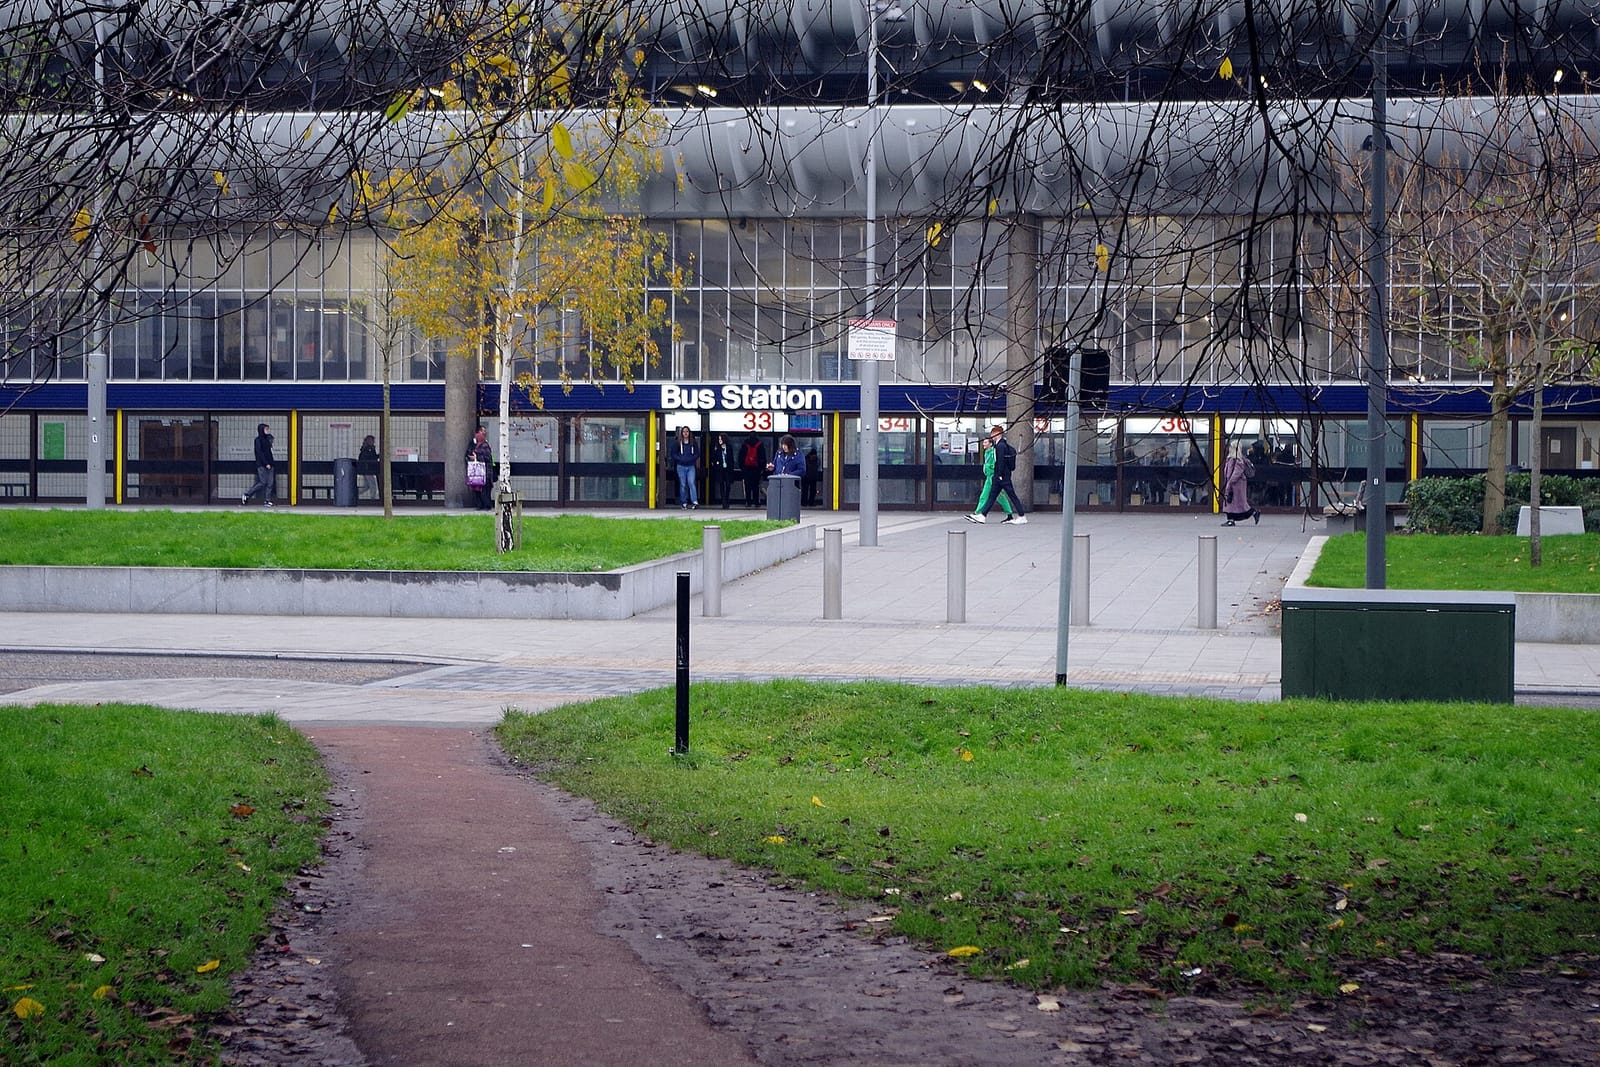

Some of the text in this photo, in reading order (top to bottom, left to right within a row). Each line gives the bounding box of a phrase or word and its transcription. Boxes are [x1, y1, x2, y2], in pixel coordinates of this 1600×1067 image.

[661, 384, 823, 409] Bus Station
[744, 411, 772, 430] 33
[879, 417, 909, 431] 34
[1161, 416, 1191, 432] 36
